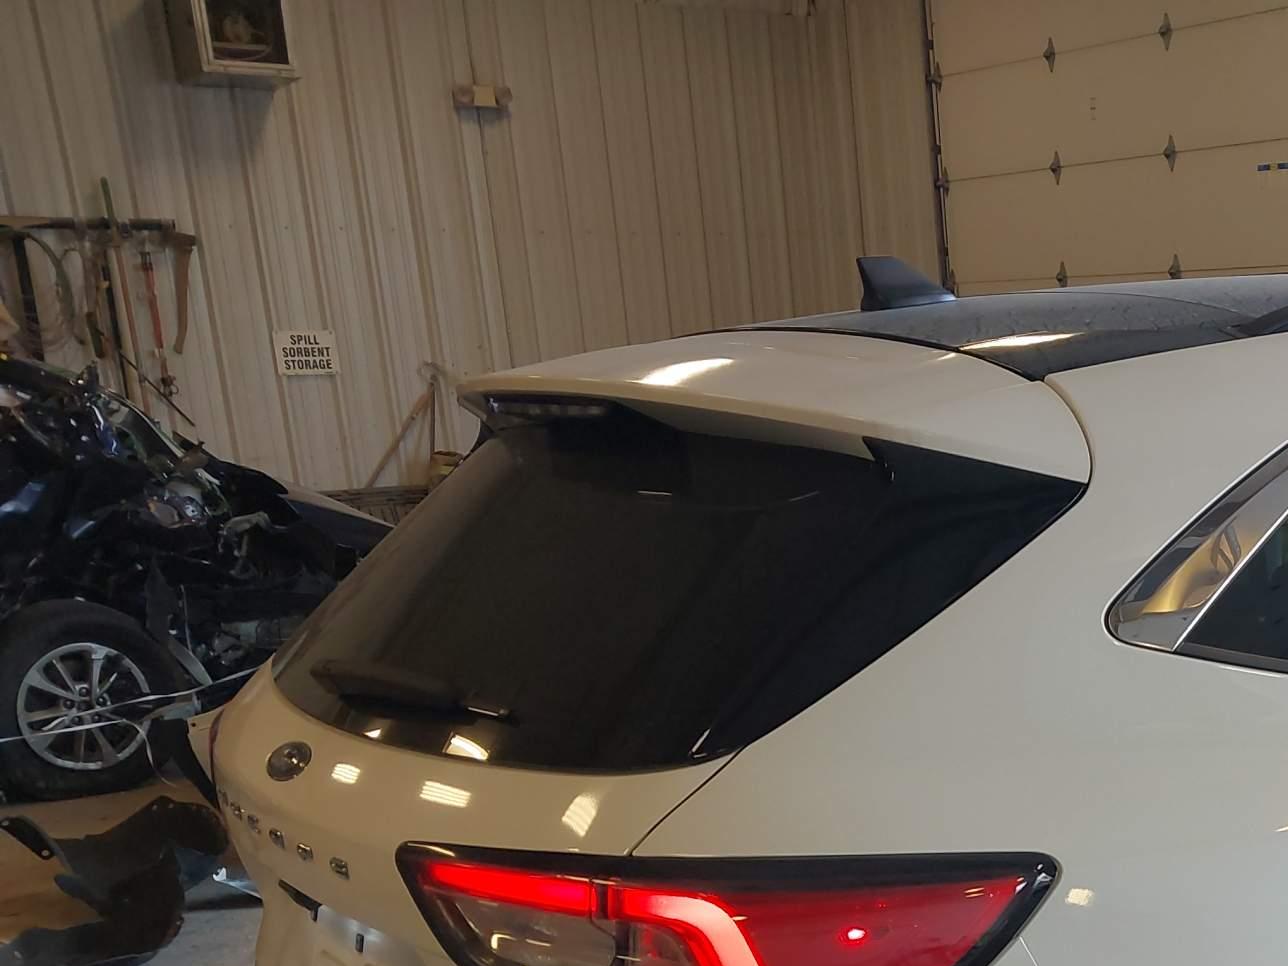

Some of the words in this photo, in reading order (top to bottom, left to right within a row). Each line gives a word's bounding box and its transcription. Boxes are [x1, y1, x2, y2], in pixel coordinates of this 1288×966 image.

[289, 334, 320, 345] SPILL
[282, 347, 330, 358] SORBENT
[284, 359, 333, 370] STORAGE
